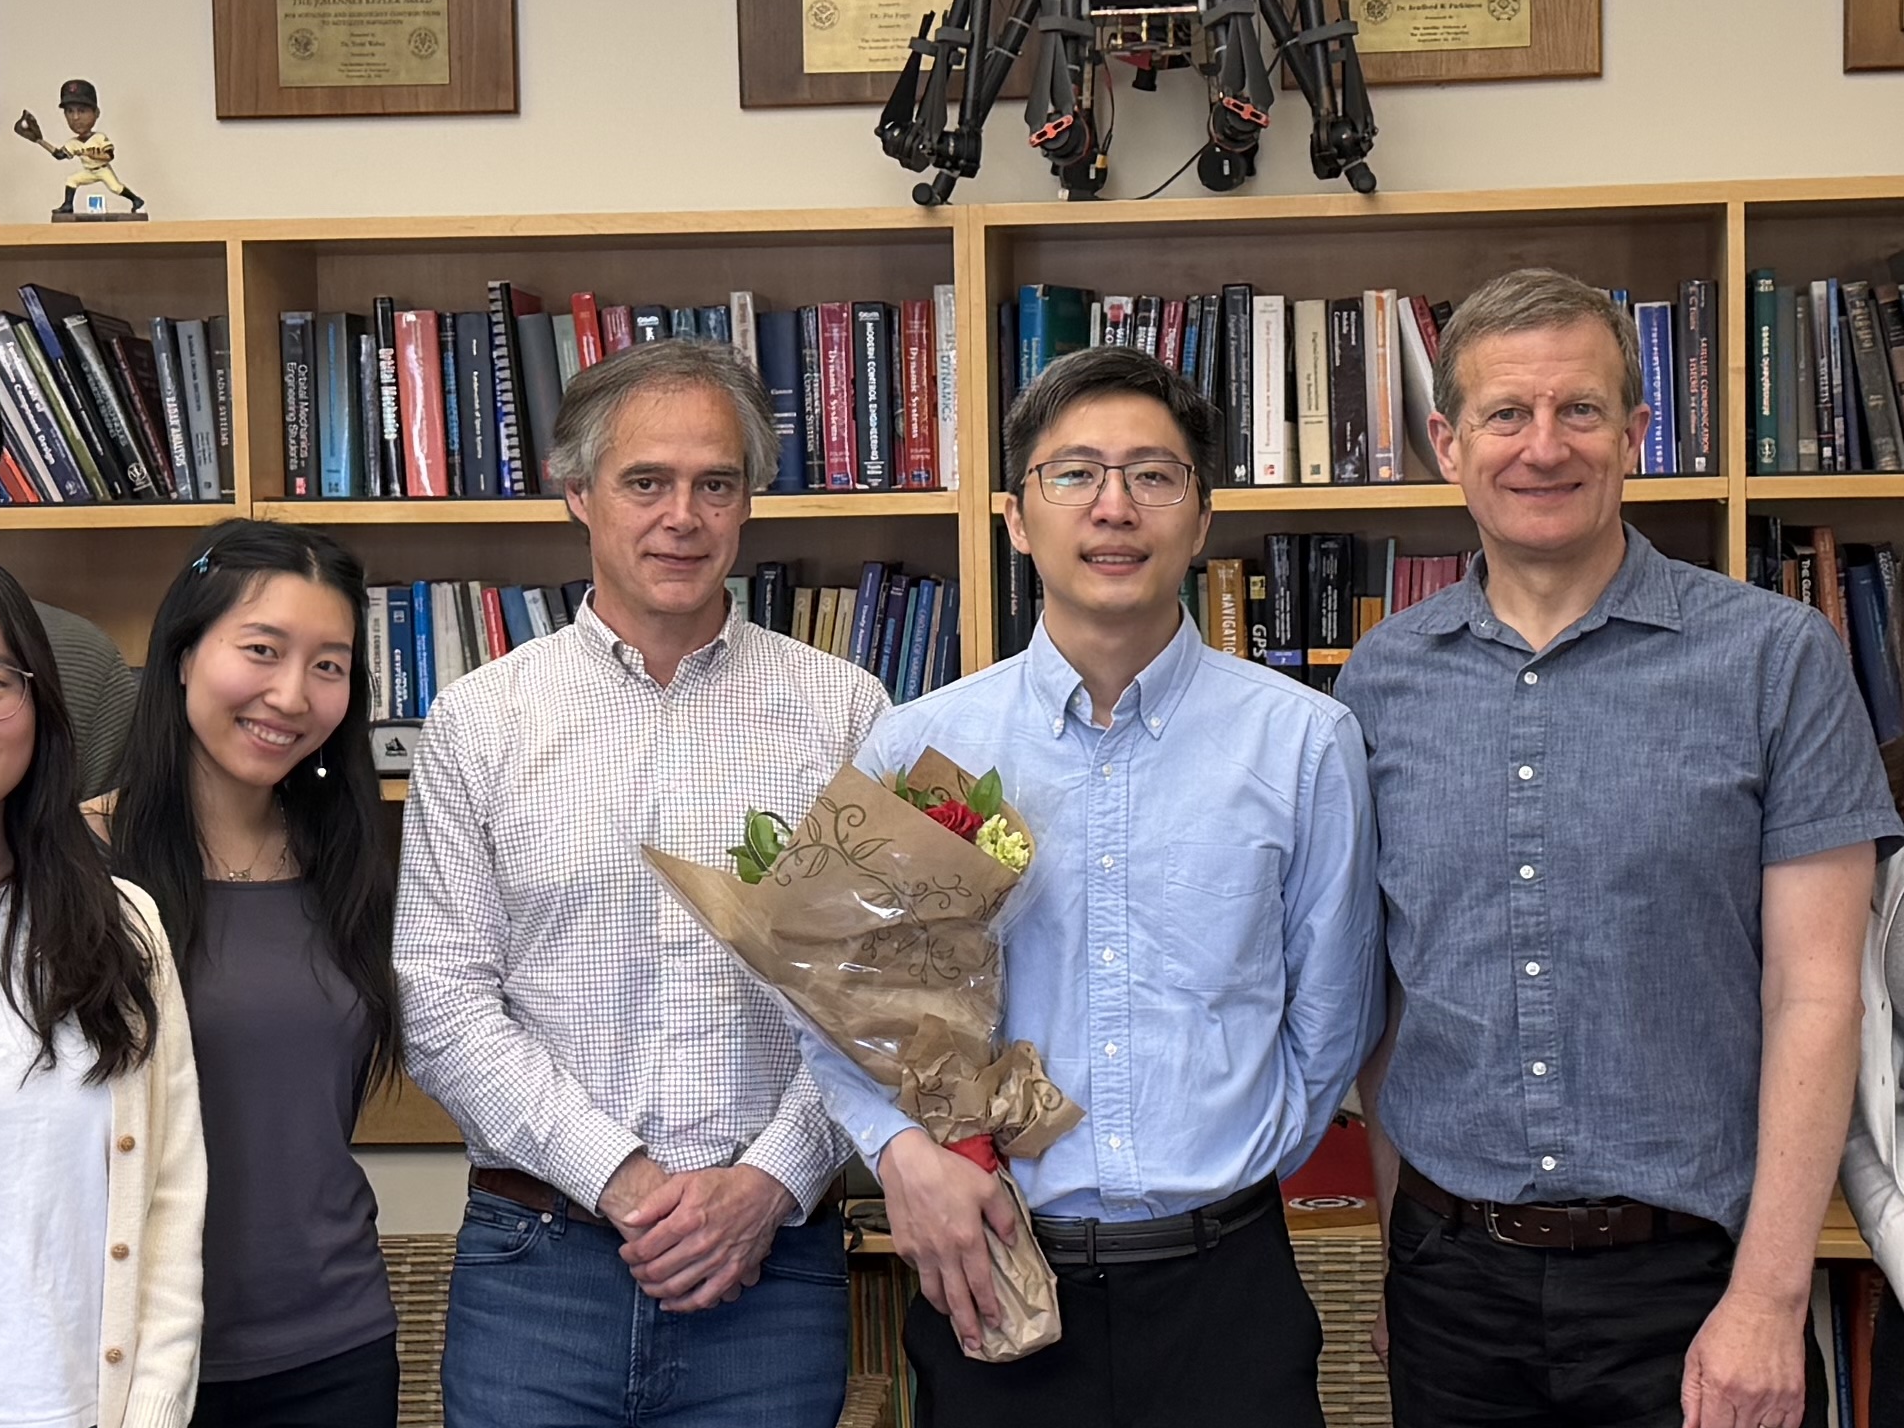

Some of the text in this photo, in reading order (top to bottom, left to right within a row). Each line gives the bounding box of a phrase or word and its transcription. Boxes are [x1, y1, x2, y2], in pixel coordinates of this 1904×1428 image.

[1408, 3, 1438, 11] Bradford
[1448, 2, 1482, 10] Parkinson
[6, 342, 42, 402] Fundamentals
[1164, 327, 1175, 359] Digital
[1311, 332, 1319, 355] Digital
[1689, 358, 1699, 394] SYSTEMS
[1760, 326, 1771, 416] atmospheric waves
[165, 396, 180, 426] RADAR
[216, 369, 229, 447] RADAR SYSTEMS
[284, 362, 300, 471] Engineering Students
[298, 364, 311, 458] Orbital Mechanics
[377, 348, 400, 440] Orbital Mechanics
[803, 373, 815, 453] CONTROL SYSTEMS
[827, 350, 840, 442] Dynamic Systems
[865, 322, 879, 461] MODERN CONTROL ENGINEERING
[907, 347, 921, 439] Dynamic Systems
[940, 355, 952, 422] DYNAMICS
[1651, 327, 1664, 463] THE FIRST TO DIE AT THE END
[1699, 337, 1711, 454] SATELLITE COMMUNICATION
[13, 384, 42, 433] Component
[37, 434, 55, 465] Design
[170, 427, 186, 467] ANALYSIS
[1264, 410, 1272, 447] Networking
[1801, 559, 1812, 578] THE
[797, 596, 807, 611] 2
[821, 595, 833, 611] 3
[1252, 624, 1267, 658] GPS
